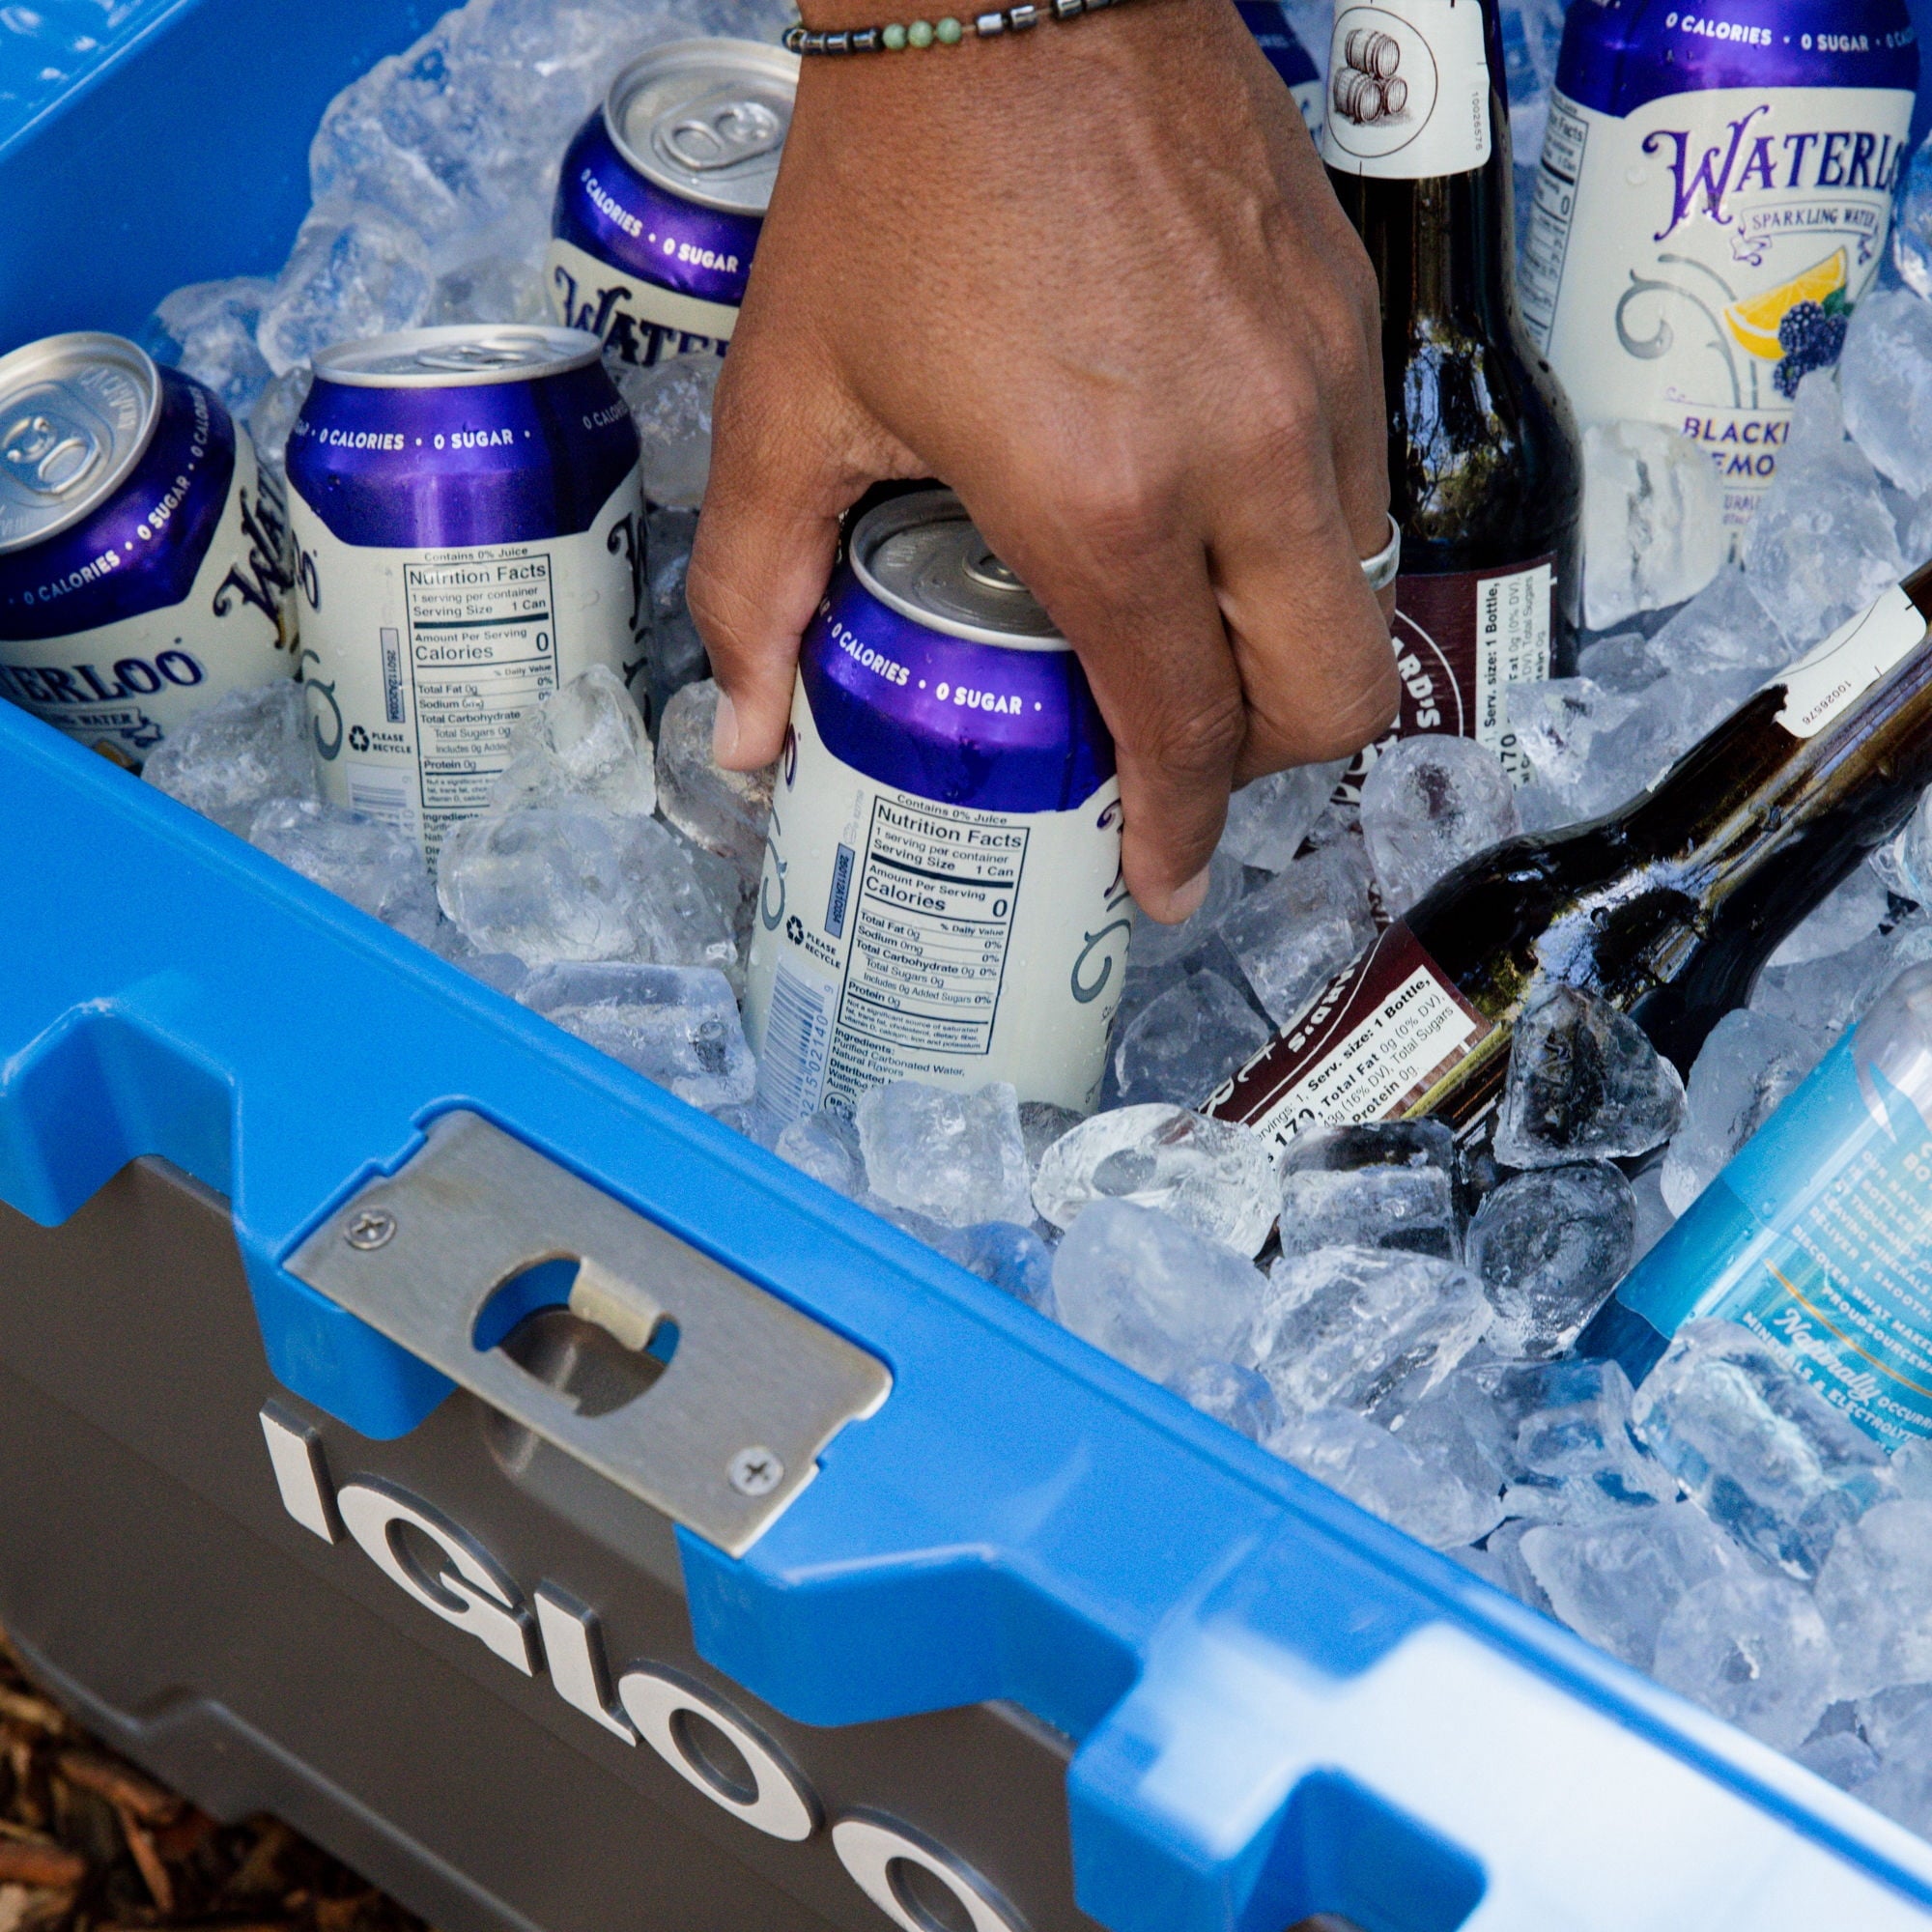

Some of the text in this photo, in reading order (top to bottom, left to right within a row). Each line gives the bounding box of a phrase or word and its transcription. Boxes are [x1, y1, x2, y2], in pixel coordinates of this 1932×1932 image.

[1665, 12, 1869, 51] 0 CALORIES 0 SUGAR
[585, 178, 739, 272] CALORIES 0 SUGAR
[1752, 209, 1837, 230] SPARKLING
[319, 428, 514, 450] 0 CALORIES 0 SUGAR
[38, 475, 191, 602] CALORIES 0 SUGAR
[425, 547, 528, 562] Contains 0% Juice
[410, 563, 547, 585] Nutrition Facts
[413, 598, 547, 618] Serving Size Can
[421, 586, 538, 604] serving per container
[1486, 582, 1500, 635] Bottle,
[415, 628, 527, 642] Amount Per Serving
[415, 632, 550, 661] Calories 0
[0, 650, 206, 703] ERLOO
[832, 623, 1022, 715] 0 CALORIES 0 SUGAR
[419, 683, 463, 695] Total Fat
[419, 698, 459, 709] Sodium
[78, 713, 133, 725] WATER
[421, 711, 521, 724] Total Carbohydrate
[1485, 688, 1496, 727] Serv.
[372, 732, 404, 742] PLEASE
[373, 744, 412, 753] RECYCLE
[435, 727, 496, 740] Total Sugars
[436, 744, 469, 754] Includes
[424, 760, 461, 770] Protein
[897, 794, 1008, 825] Contains 0% Juice
[878, 804, 960, 840] Nutrition
[968, 830, 1022, 848] Facts
[874, 838, 1013, 876] Serving Size Can
[885, 831, 1009, 864] serving per container
[866, 876, 1008, 918] Calories 0
[869, 865, 986, 902] Amount Per Serving
[807, 931, 837, 955] PLEASE
[858, 925, 1000, 963] Sodium 0mg 0%
[861, 912, 1002, 950] Total Fat 0g 0%
[952, 924, 1005, 937] Daily Value
[805, 943, 841, 969] RECYCLE
[856, 939, 997, 979] Total Carbohydrate 0g 0%
[867, 957, 944, 988] Total Sugars 0g
[848, 981, 901, 1009] Protein 0g
[864, 973, 896, 990] Includes
[912, 987, 943, 1000] Added
[942, 994, 972, 1005] Sugars
[974, 995, 991, 1005] 0%
[847, 999, 860, 1009] Not
[867, 1005, 903, 1022] significant
[835, 1027, 895, 1056] Ingredients:
[844, 1015, 868, 1030] vitamin
[926, 1037, 942, 1046] and
[1308, 980, 1431, 1091] Serv. size: Bottle,
[1390, 1039, 1417, 1065] Total
[1417, 1007, 1454, 1041] Sugars
[830, 1058, 885, 1085] Distributed
[832, 1046, 904, 1077] Natural Flavors
[834, 1037, 965, 1078] Purified Carbonated Water,
[1321, 1074, 1356, 1107] Total
[1356, 1054, 1379, 1075] Fat
[1380, 1038, 1397, 1054] 0g
[1395, 1017, 1418, 1039] (0%
[826, 1078, 858, 1097] Austin,
[829, 1067, 868, 1090] Waterloo
[1352, 1081, 1400, 1122] Protein
[1809, 1206, 1860, 1261] DELIVER
[1822, 1192, 1930, 1294] LEAVING MINERALS
[1851, 1193, 1919, 1262] THOUSANDS
[1791, 1224, 1932, 1354] DISCOVER WHAT MAKE
[1774, 1307, 1882, 1406] Naturally
[1743, 1311, 1927, 1442] MINERALS ELECTROLYT
